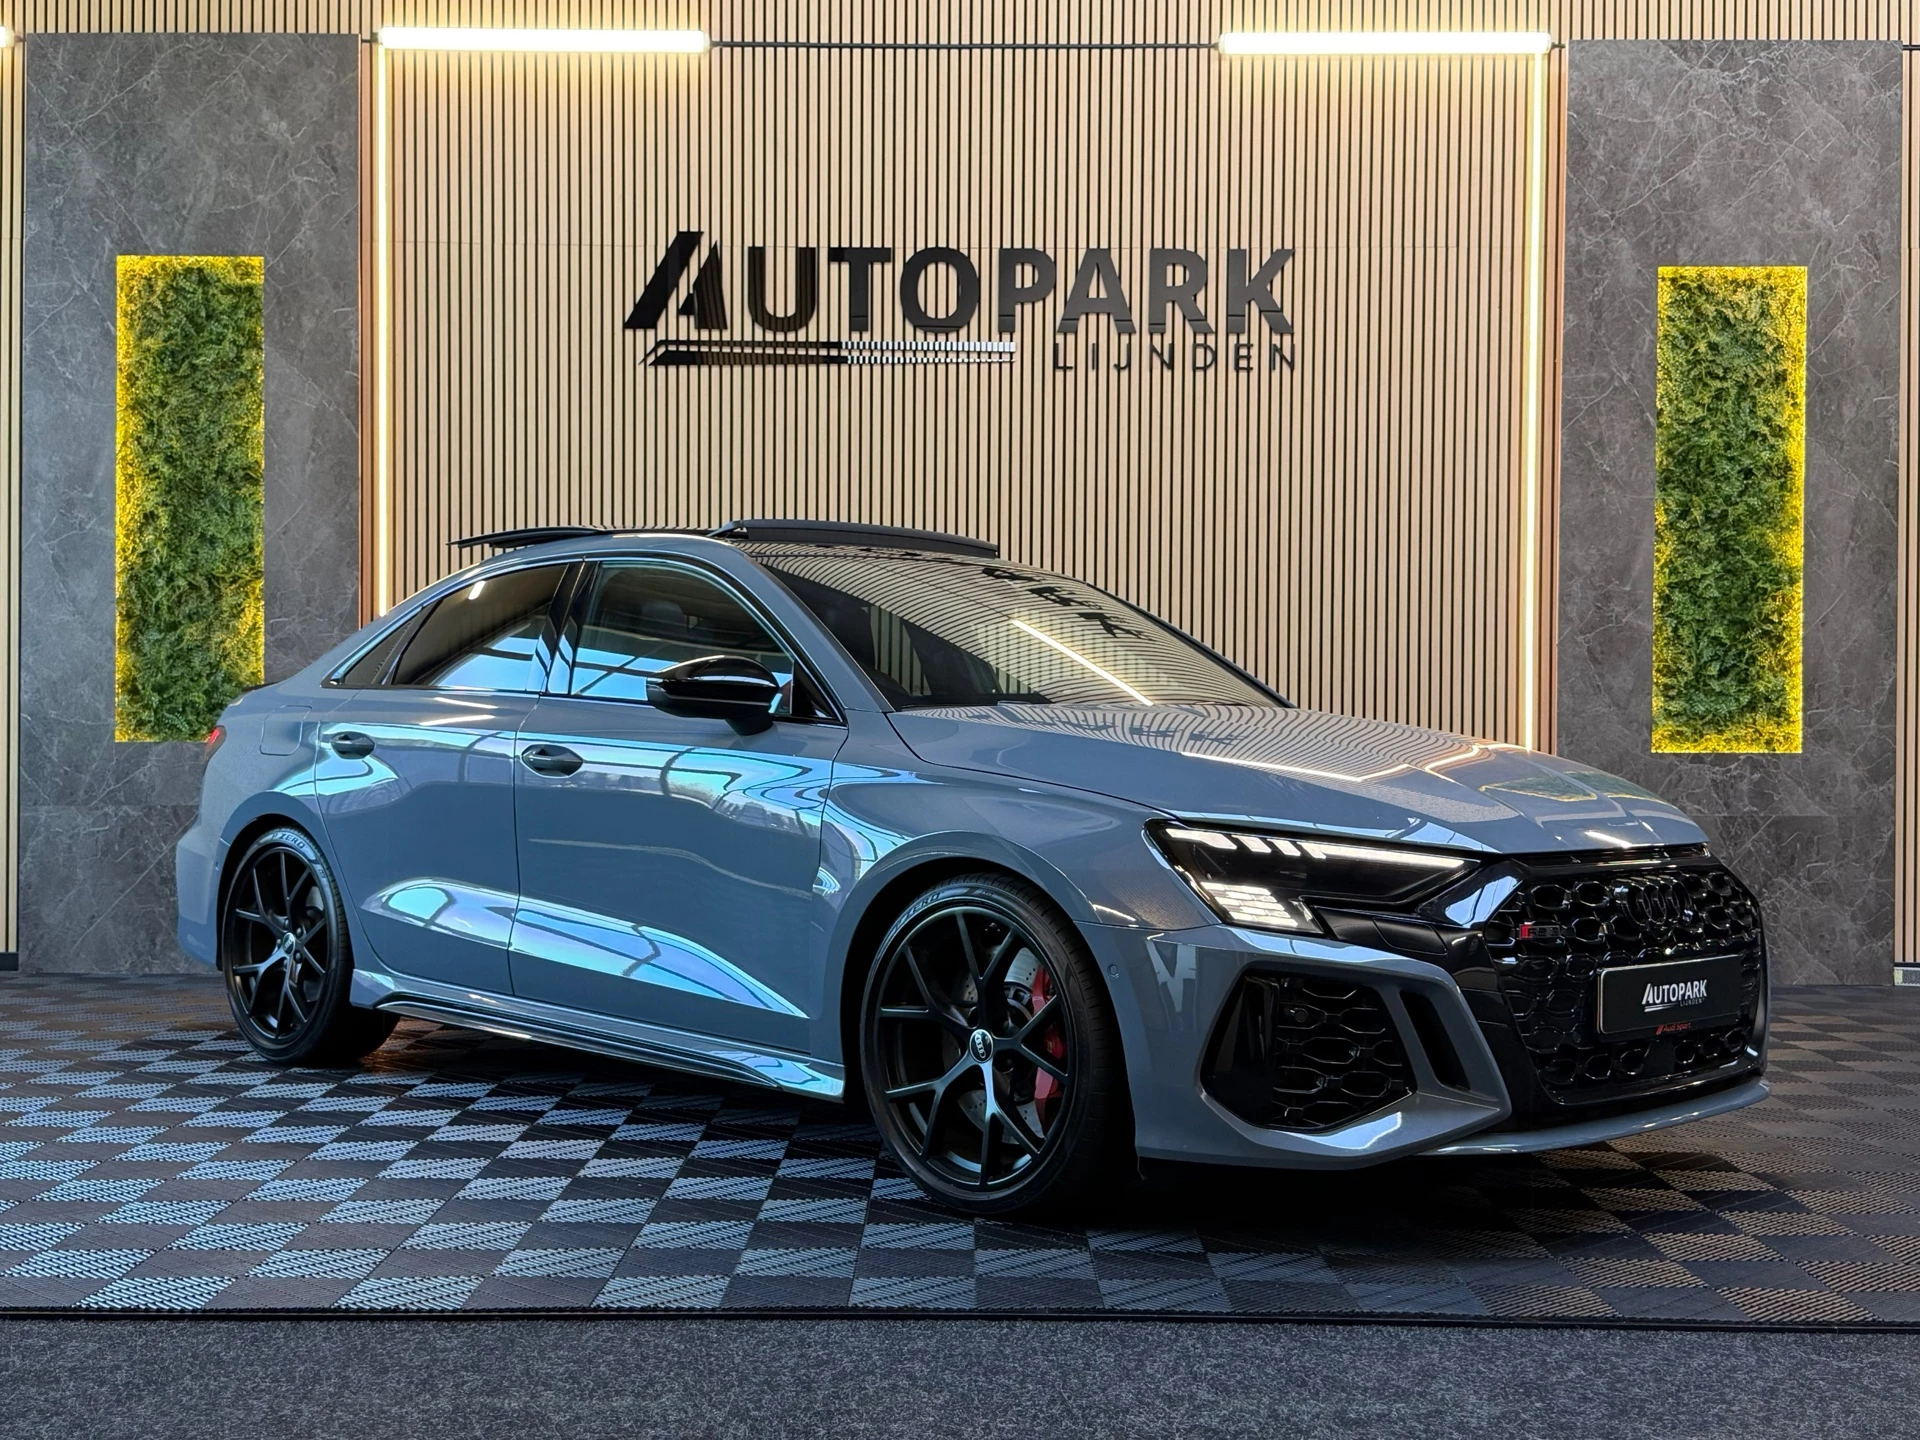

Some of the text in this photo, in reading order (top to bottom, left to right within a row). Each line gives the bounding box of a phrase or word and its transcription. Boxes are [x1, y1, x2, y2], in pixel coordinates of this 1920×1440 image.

[623, 230, 1296, 334] AUTOPARK
[1053, 342, 1296, 373] LIJNDEN
[279, 833, 306, 849] ZERO
[1642, 979, 1708, 1005] AUTOPARK
